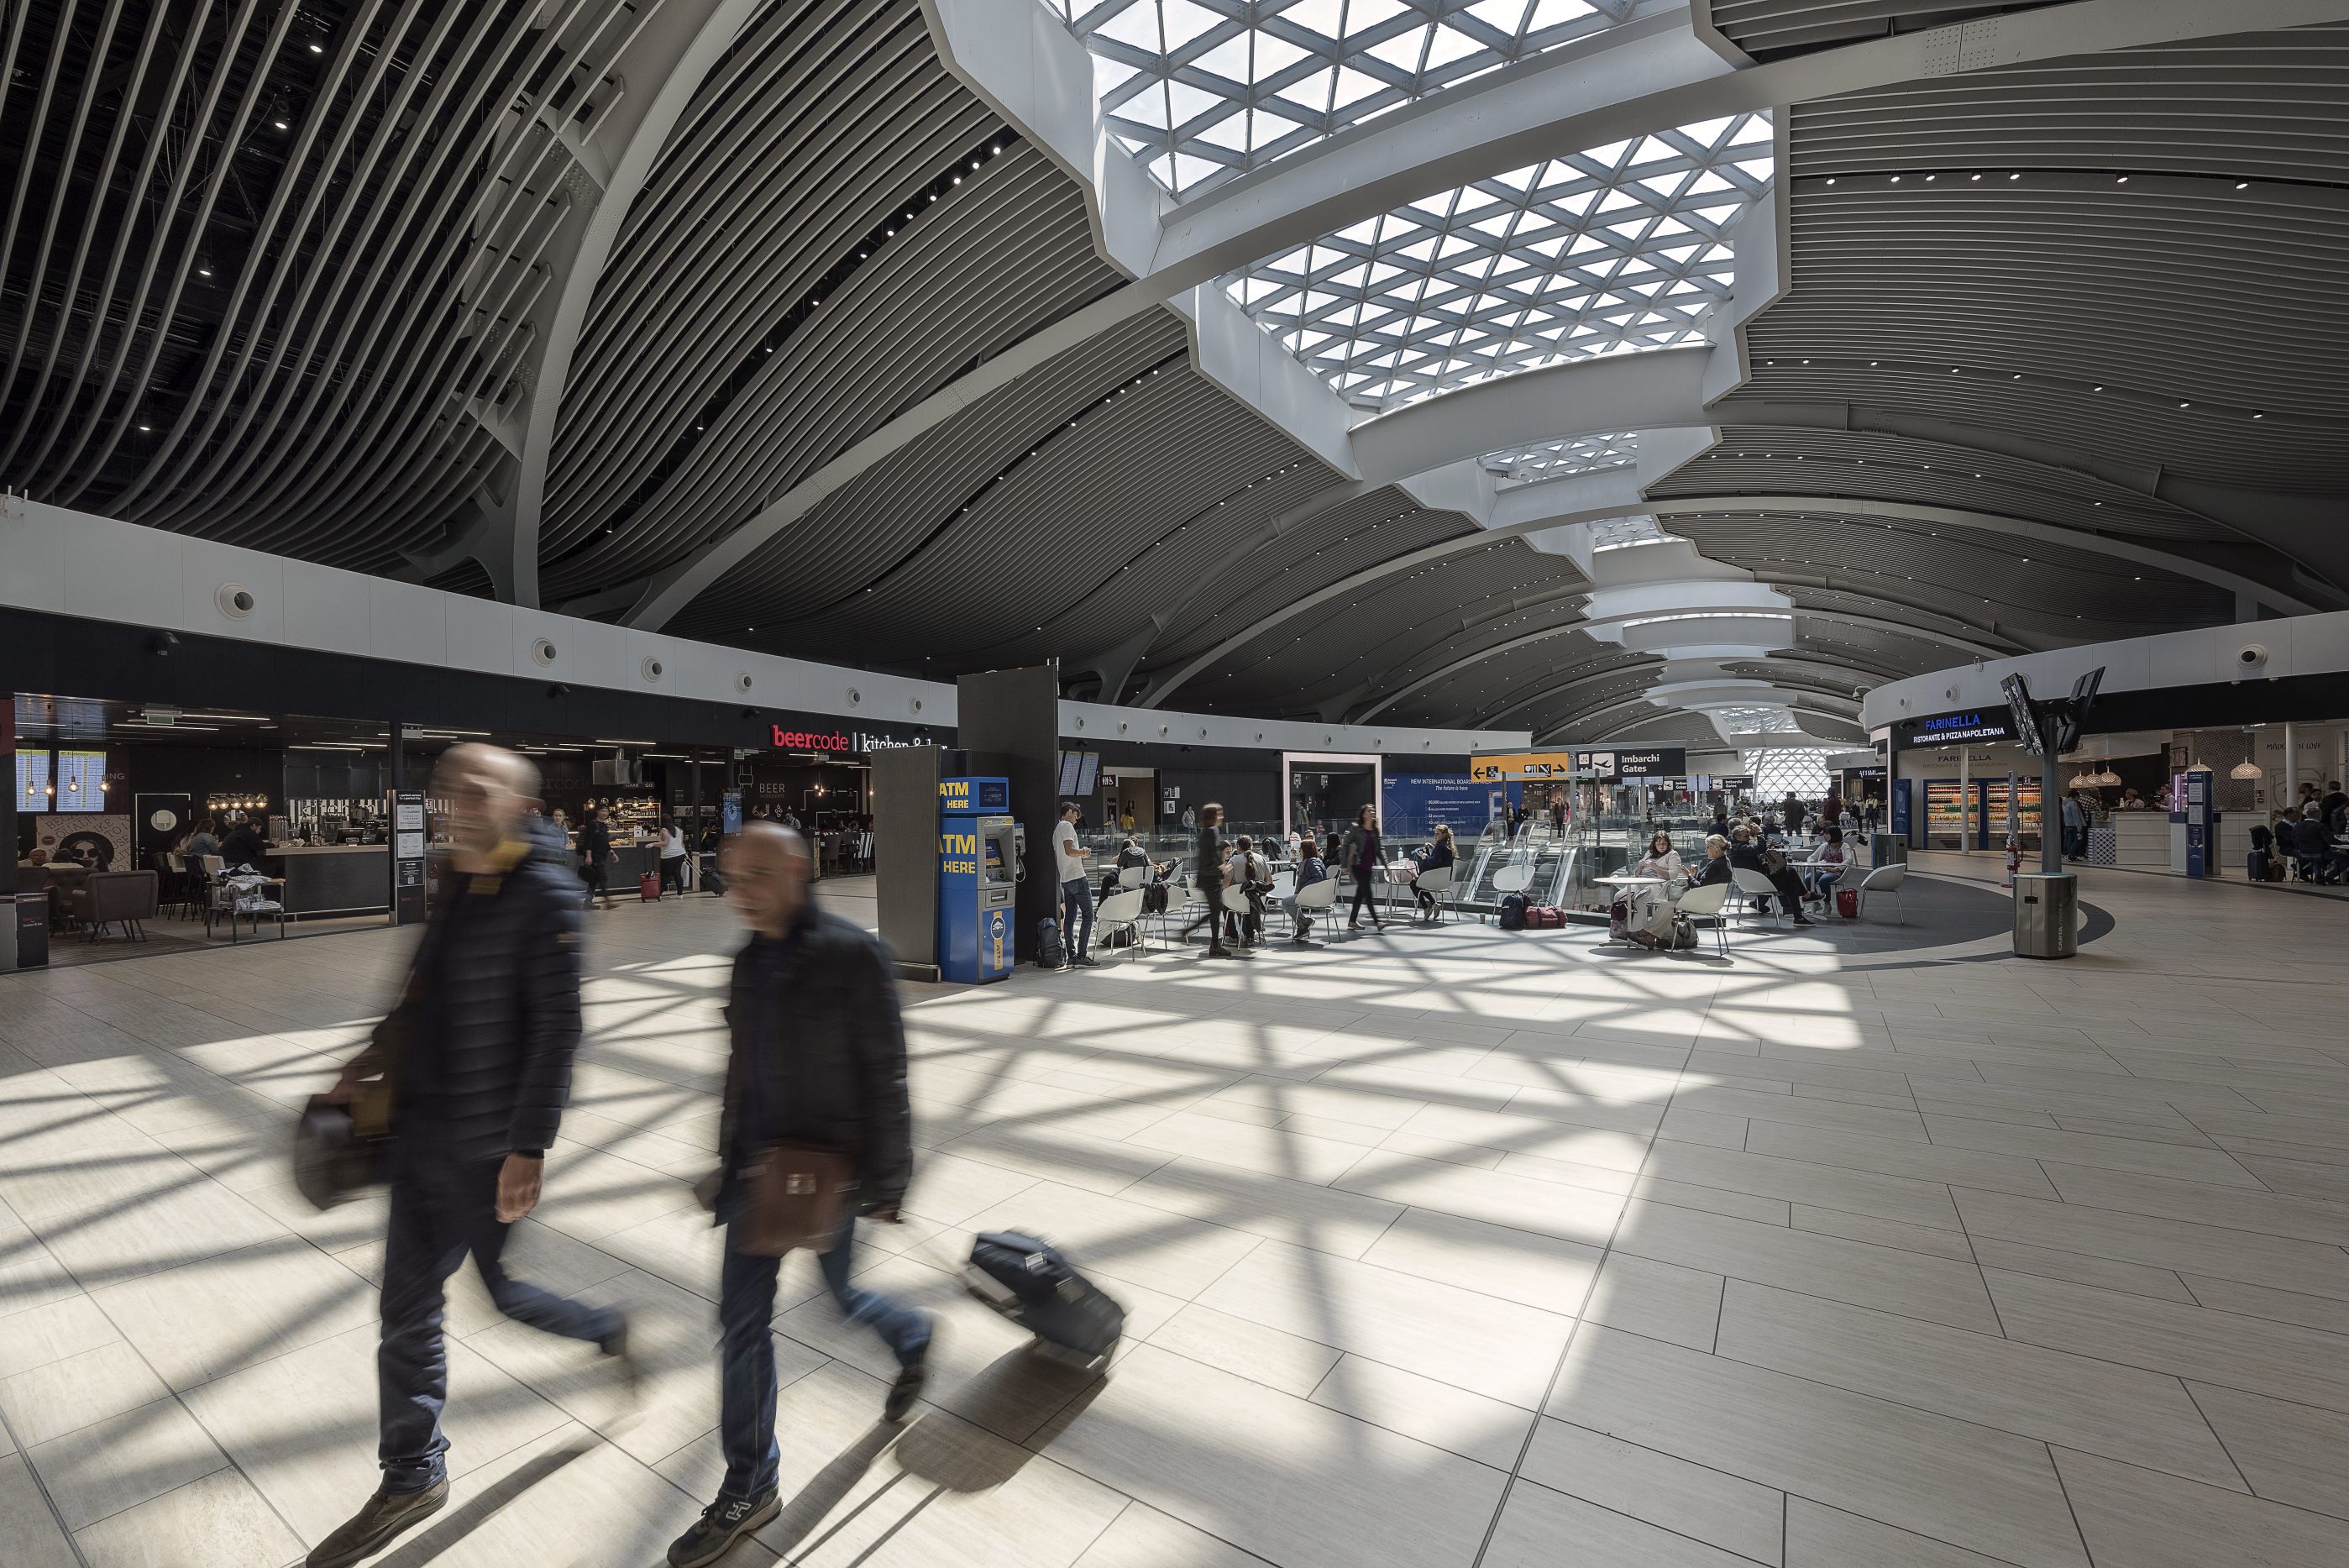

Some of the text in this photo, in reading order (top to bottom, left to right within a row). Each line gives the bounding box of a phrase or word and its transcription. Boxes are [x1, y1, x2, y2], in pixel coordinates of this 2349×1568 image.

[1926, 714, 1981, 731] FARINELLA
[771, 724, 849, 752] beercode
[1913, 733, 1941, 743] RISTORANTE
[1946, 732, 1963, 740] PIZZA
[1963, 727, 2005, 737] NAPOLETANA
[2306, 741, 2321, 750] LOVE
[1621, 754, 1660, 763] Imbarchi
[759, 783, 786, 794] BEER
[939, 782, 969, 797] ATM
[946, 800, 969, 809] HERE
[942, 861, 976, 874] HERE
